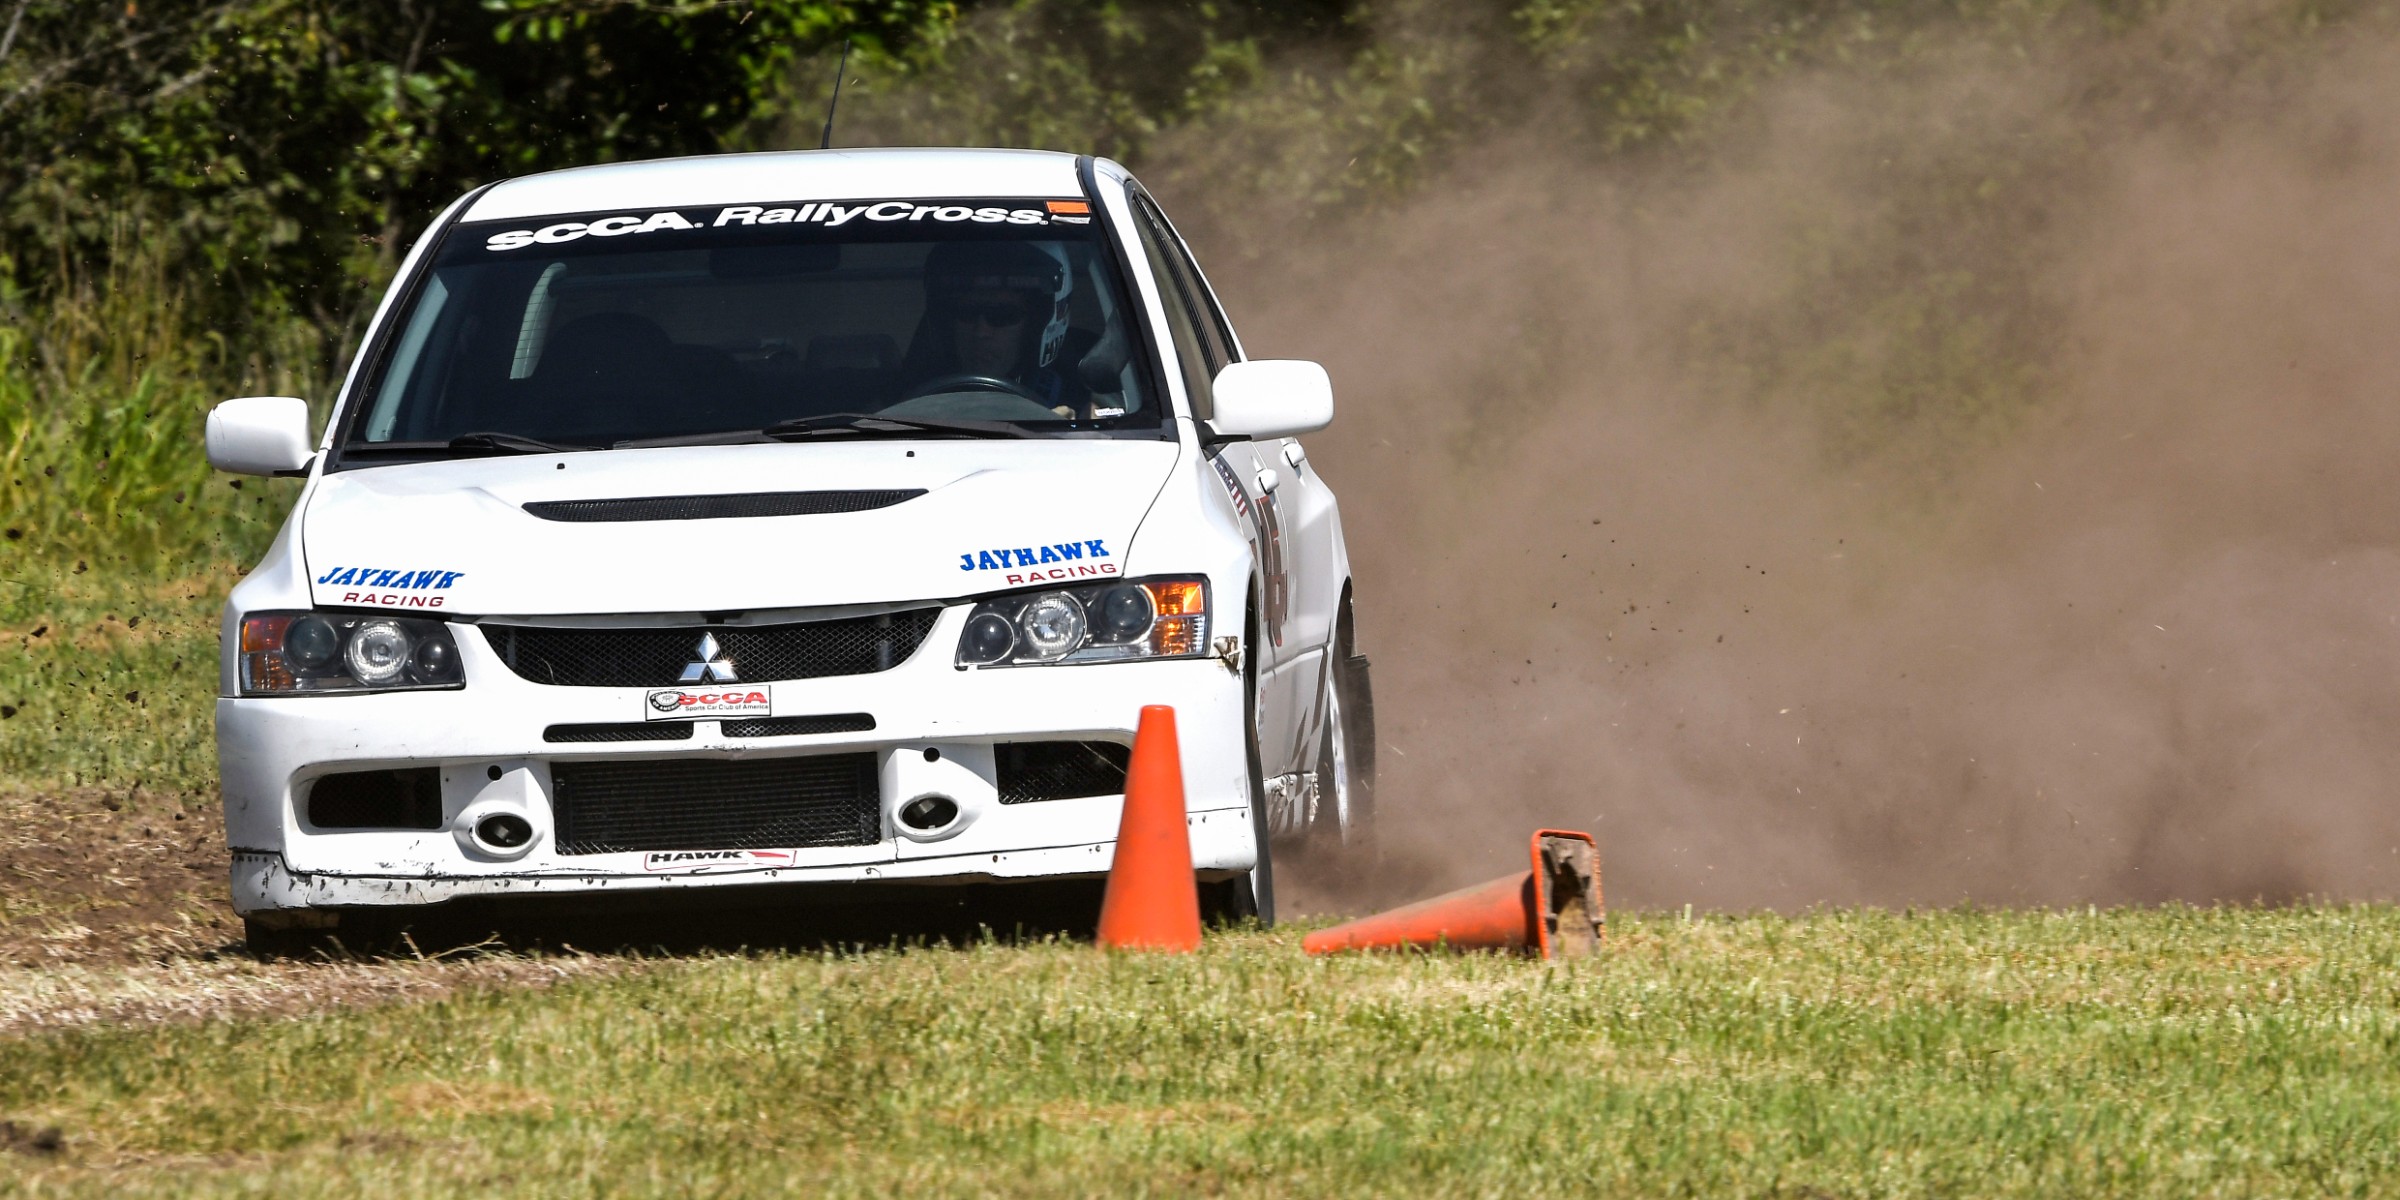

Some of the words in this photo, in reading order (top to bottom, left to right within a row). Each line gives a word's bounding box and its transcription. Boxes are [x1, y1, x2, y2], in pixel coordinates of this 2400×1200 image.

[960, 539, 1110, 571] JAYHAWK
[317, 567, 465, 589] JAYHAWK
[1006, 563, 1118, 585] RACING
[343, 592, 444, 607] RACING
[678, 692, 768, 705] SCCA
[650, 851, 743, 863] HAWK
